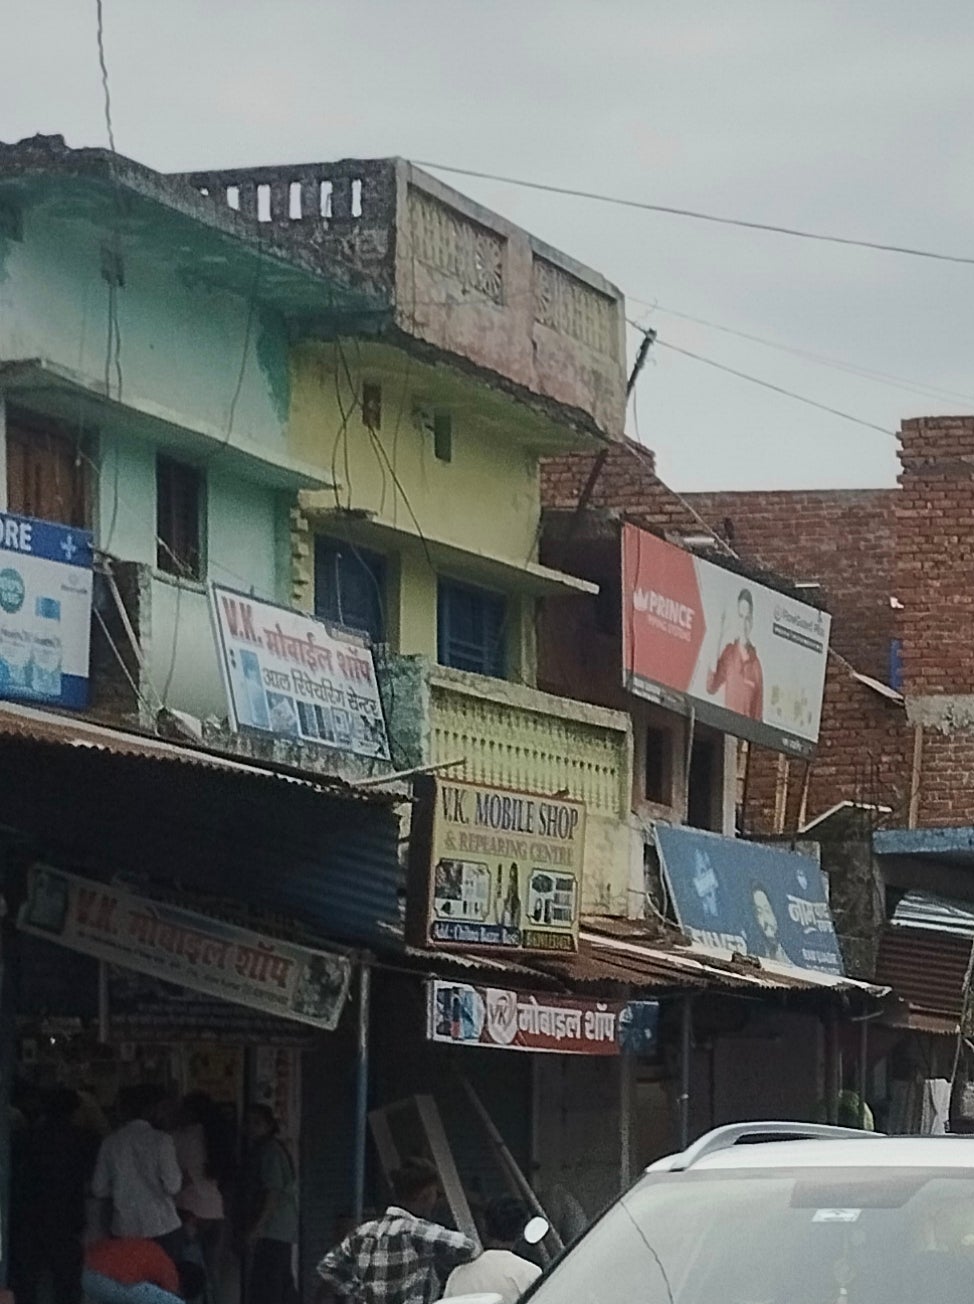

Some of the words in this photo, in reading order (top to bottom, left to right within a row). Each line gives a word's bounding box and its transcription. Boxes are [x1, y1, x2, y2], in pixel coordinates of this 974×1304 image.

[0, 519, 33, 551] RE
[649, 589, 696, 630] PRINCE
[441, 786, 469, 825] V.K.
[474, 790, 535, 834] MOBILE
[538, 802, 579, 841] SHOP
[517, 994, 583, 1041] मोबाइल
[584, 1002, 616, 1042] शॉप
